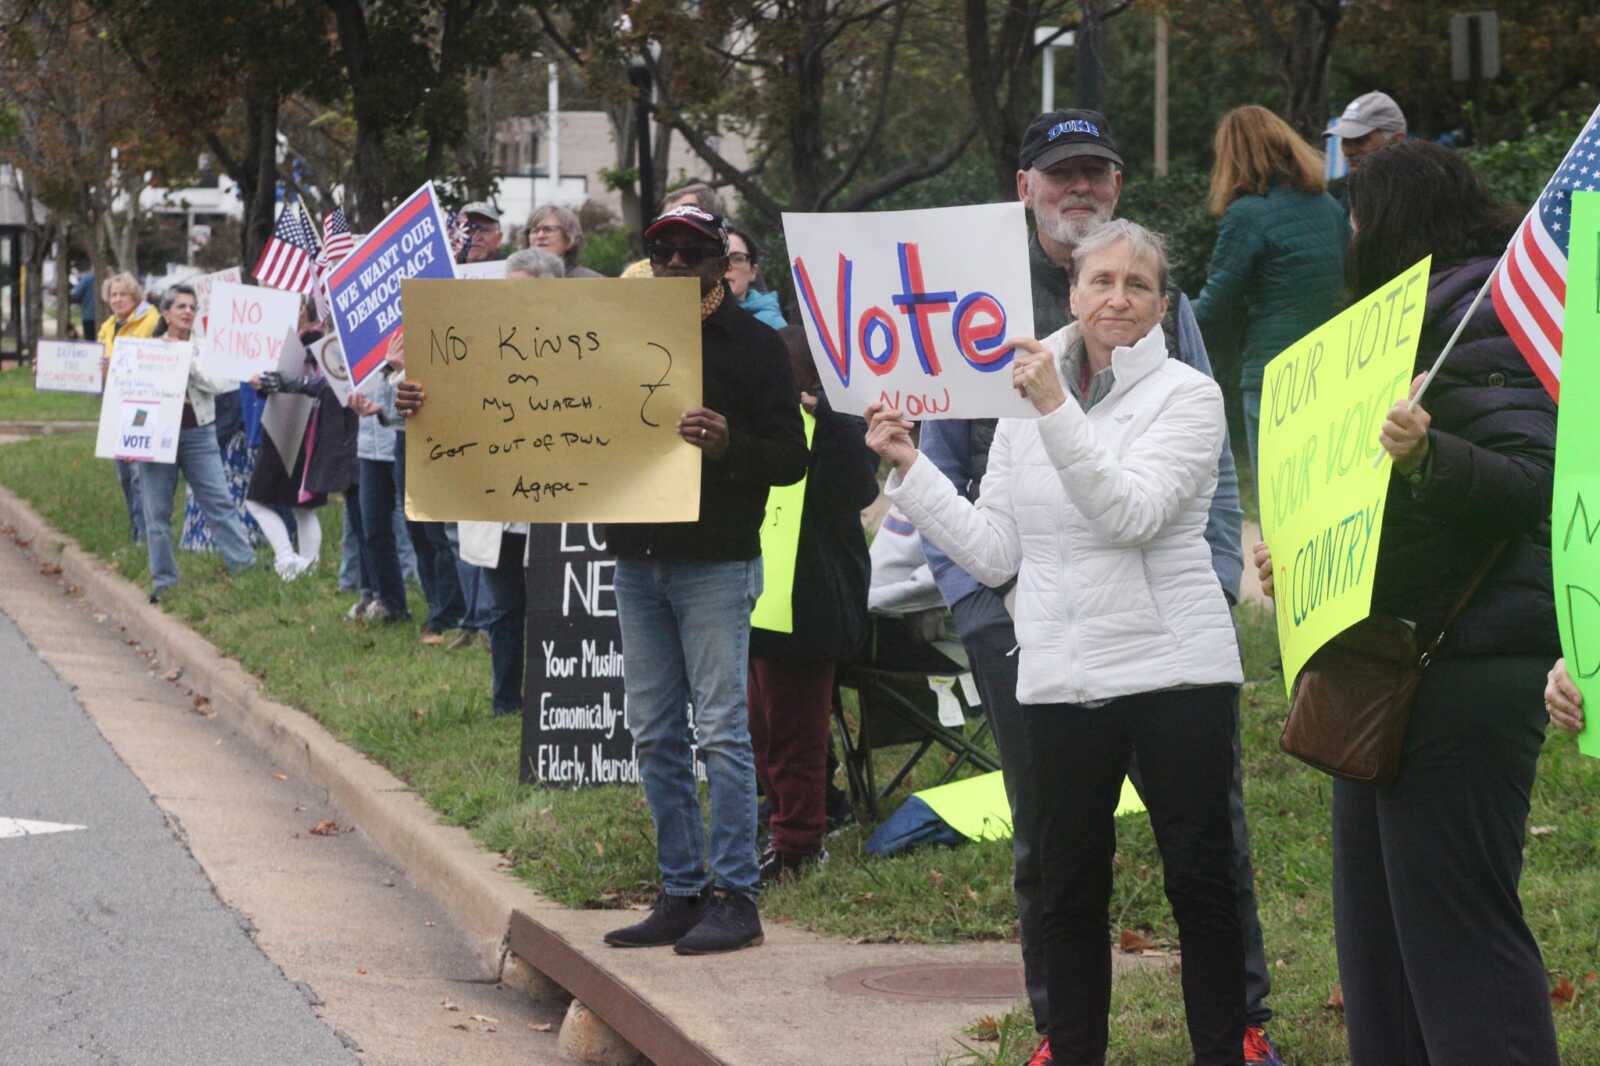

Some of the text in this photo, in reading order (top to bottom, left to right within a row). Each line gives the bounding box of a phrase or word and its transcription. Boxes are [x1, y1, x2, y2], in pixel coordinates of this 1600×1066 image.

[1047, 119, 1100, 142] DUKE
[336, 216, 435, 312] WE WANT OUR
[232, 298, 262, 324] NO
[793, 241, 1015, 388] Vote
[213, 328, 261, 359] KINGS
[430, 326, 467, 365] NO
[1268, 272, 1421, 434] YOUR VOTE
[508, 373, 539, 387] on
[123, 435, 151, 449] VOTE
[1270, 434, 1318, 534] YOUR
[1292, 498, 1380, 627] COUNTRY
[542, 640, 578, 678] Your
